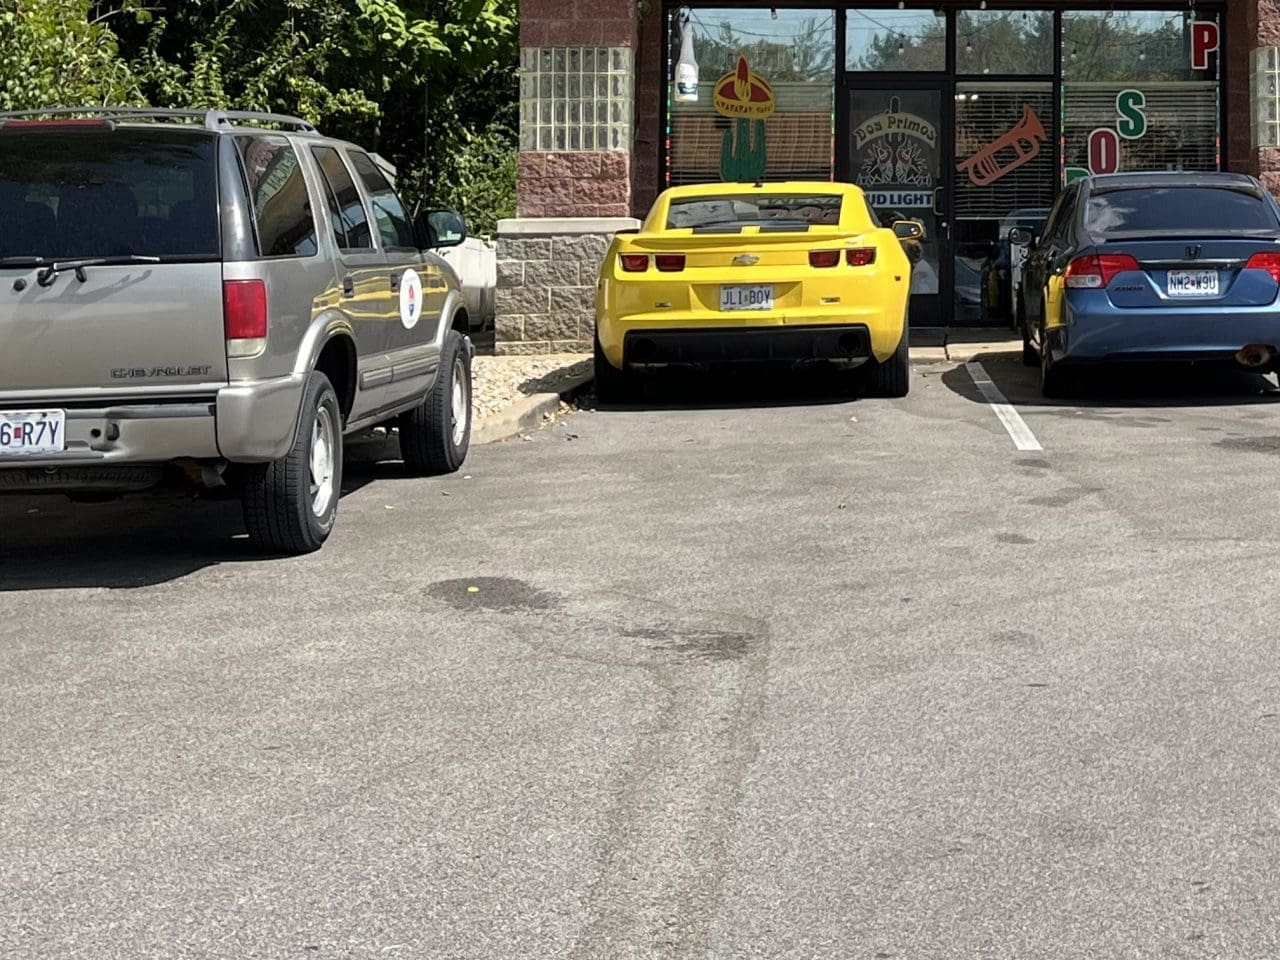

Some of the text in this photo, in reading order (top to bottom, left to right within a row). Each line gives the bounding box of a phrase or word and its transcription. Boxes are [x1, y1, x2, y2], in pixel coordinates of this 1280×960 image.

[857, 115, 935, 141] Dos Primos
[889, 193, 934, 205] LIGHT
[111, 366, 212, 378] CHEVROLET
